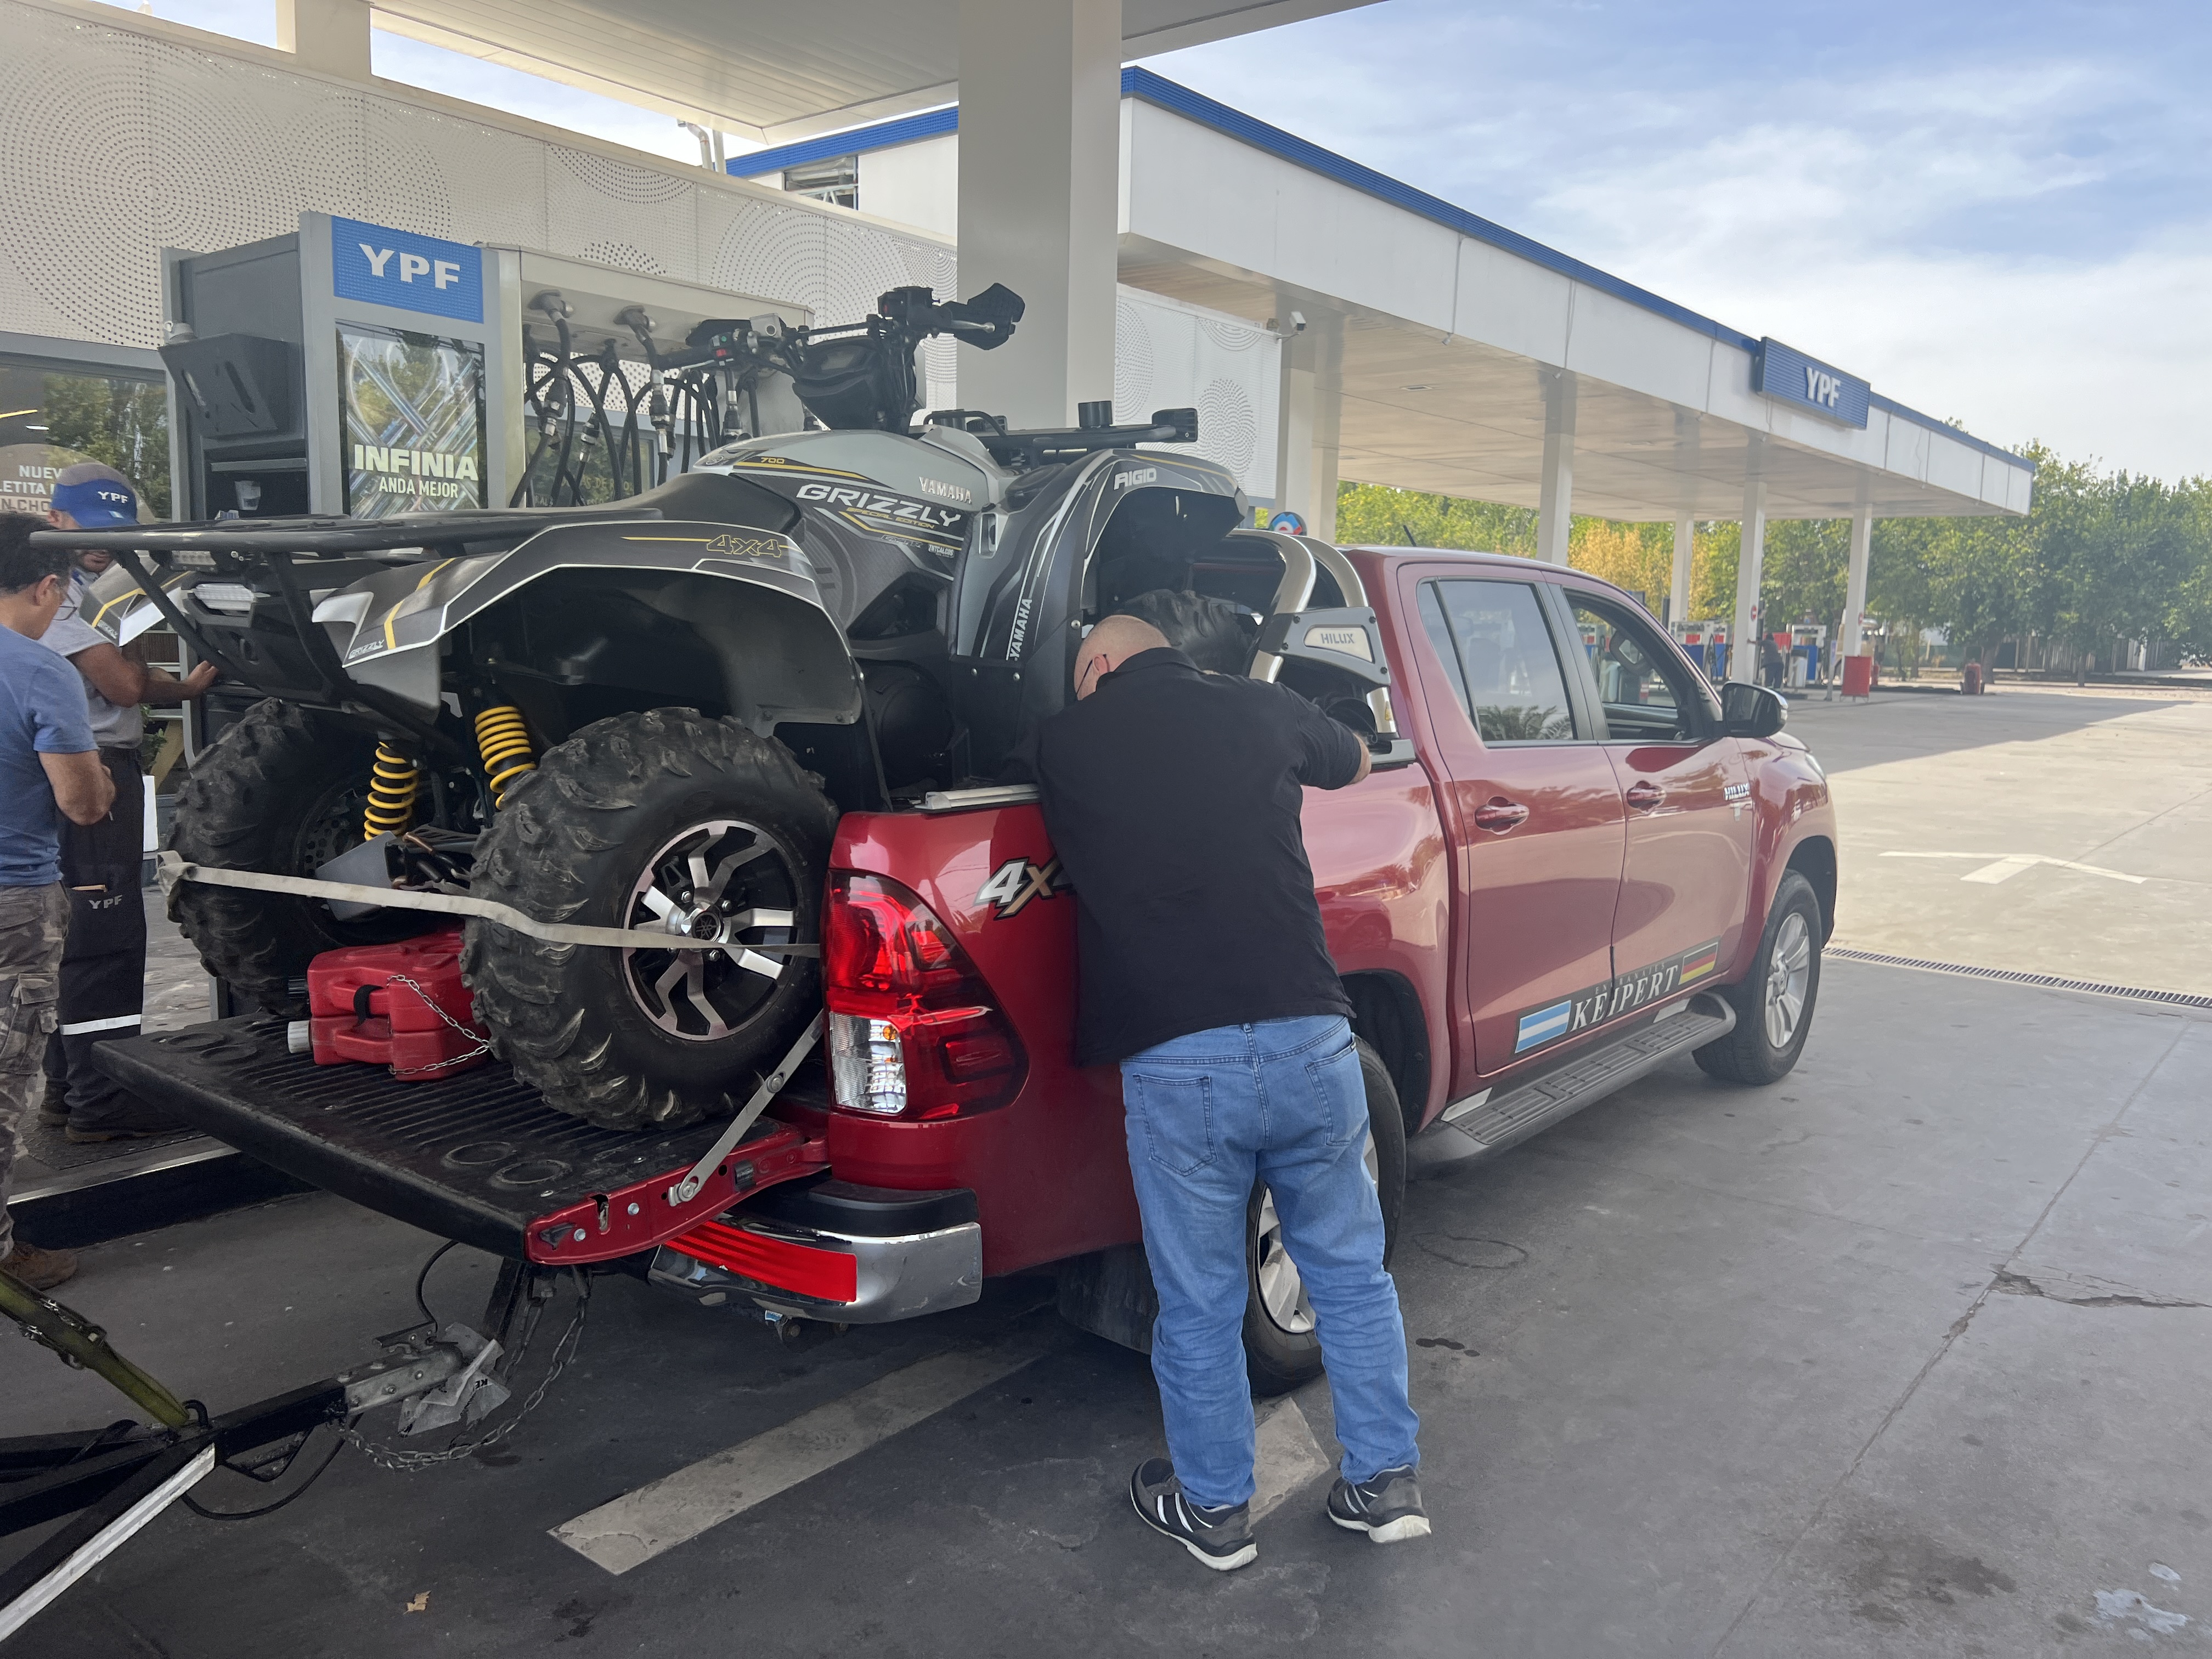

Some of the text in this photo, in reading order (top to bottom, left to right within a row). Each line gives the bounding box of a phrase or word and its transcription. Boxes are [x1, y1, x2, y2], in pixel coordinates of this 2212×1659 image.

[358, 243, 460, 289] YPF
[1807, 366, 1841, 407] YPF
[354, 444, 478, 481] INFINIA
[0, 480, 46, 495] ETITA
[98, 492, 128, 504] YPF
[379, 476, 458, 498] ANDA MEJOR
[919, 476, 972, 504] YAMAHA
[796, 484, 962, 527] GRIZZLY
[846, 507, 935, 529] SPECIAL EDITION
[1009, 599, 1032, 657] YAMAHA
[1321, 633, 1355, 644] HILUX
[1724, 783, 1750, 800] HILUX
[88, 895, 122, 909] YPF
[1570, 965, 1678, 1032] KEIPERT
